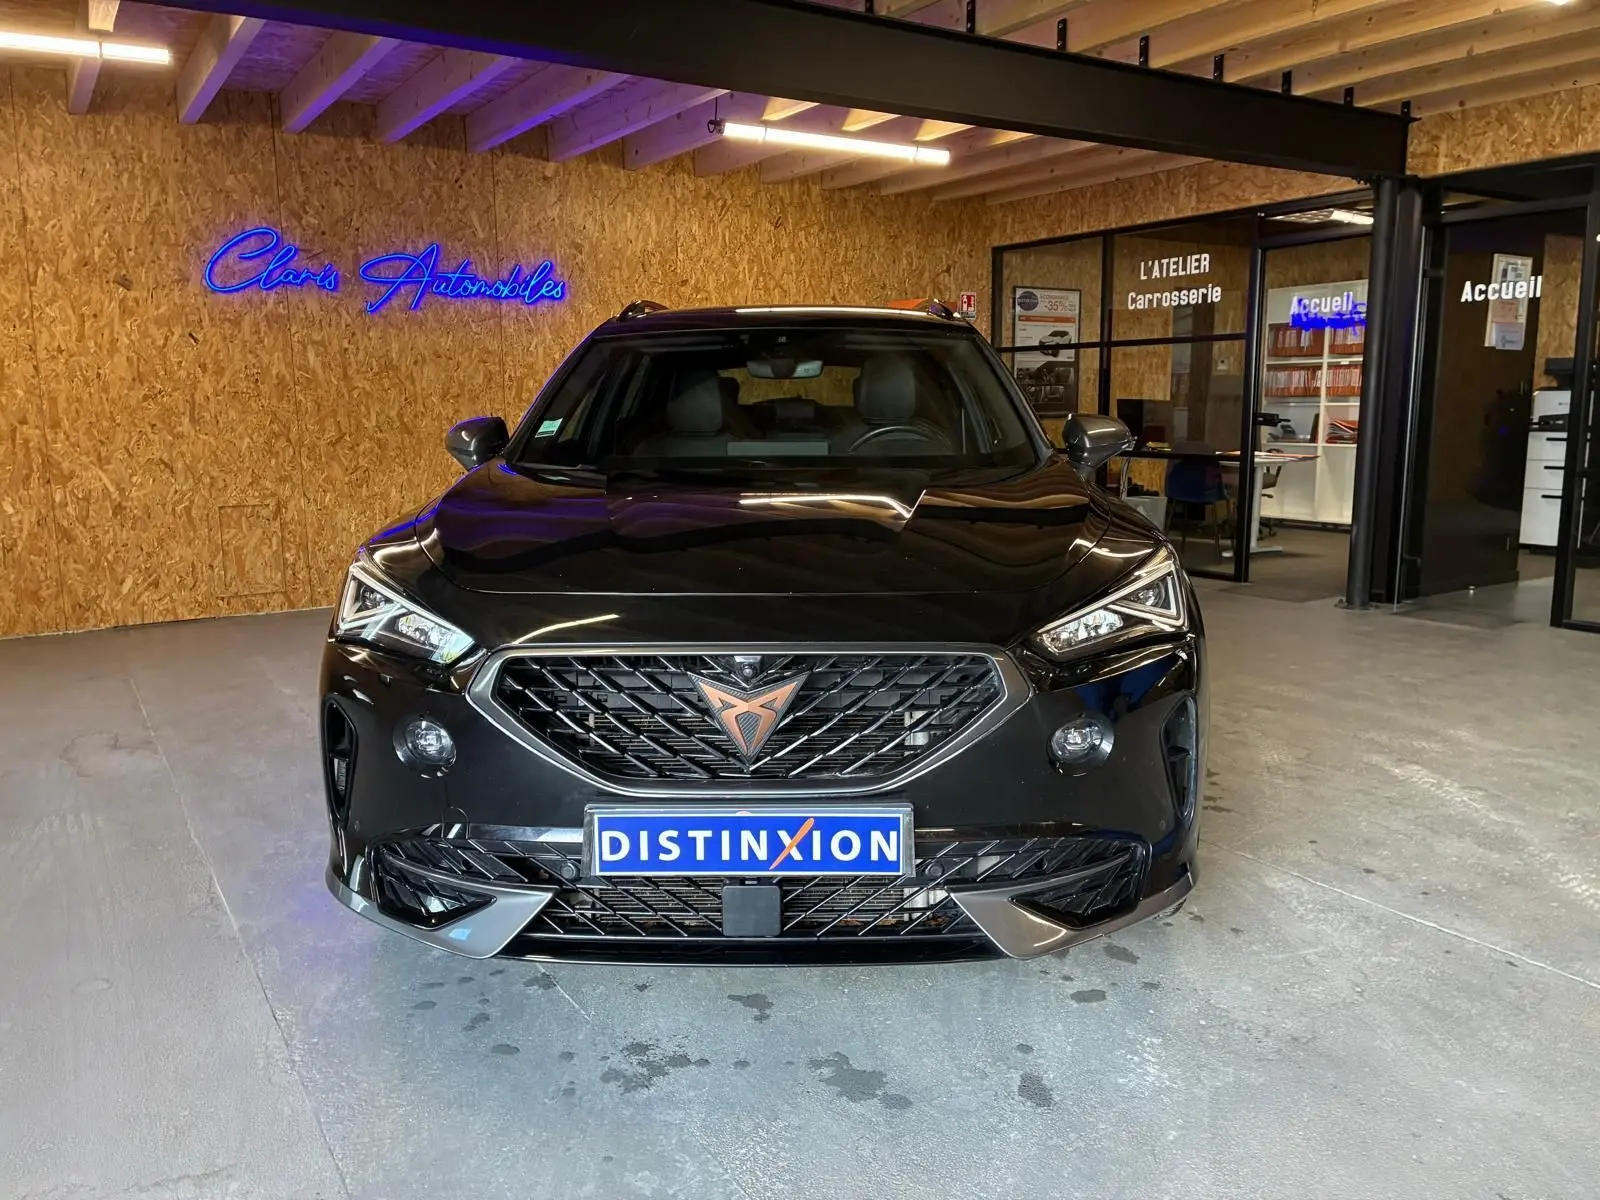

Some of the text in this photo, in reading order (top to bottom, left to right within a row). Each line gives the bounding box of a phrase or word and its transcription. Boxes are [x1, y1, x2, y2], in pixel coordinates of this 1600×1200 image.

[204, 227, 565, 314] Claris Automobiles
[1140, 253, 1210, 280] L'ATELIER
[1127, 284, 1222, 310] Carrosserie
[1460, 275, 1543, 303] Accueil
[1290, 291, 1353, 315] Accueil
[601, 818, 898, 870] DISTINXION
